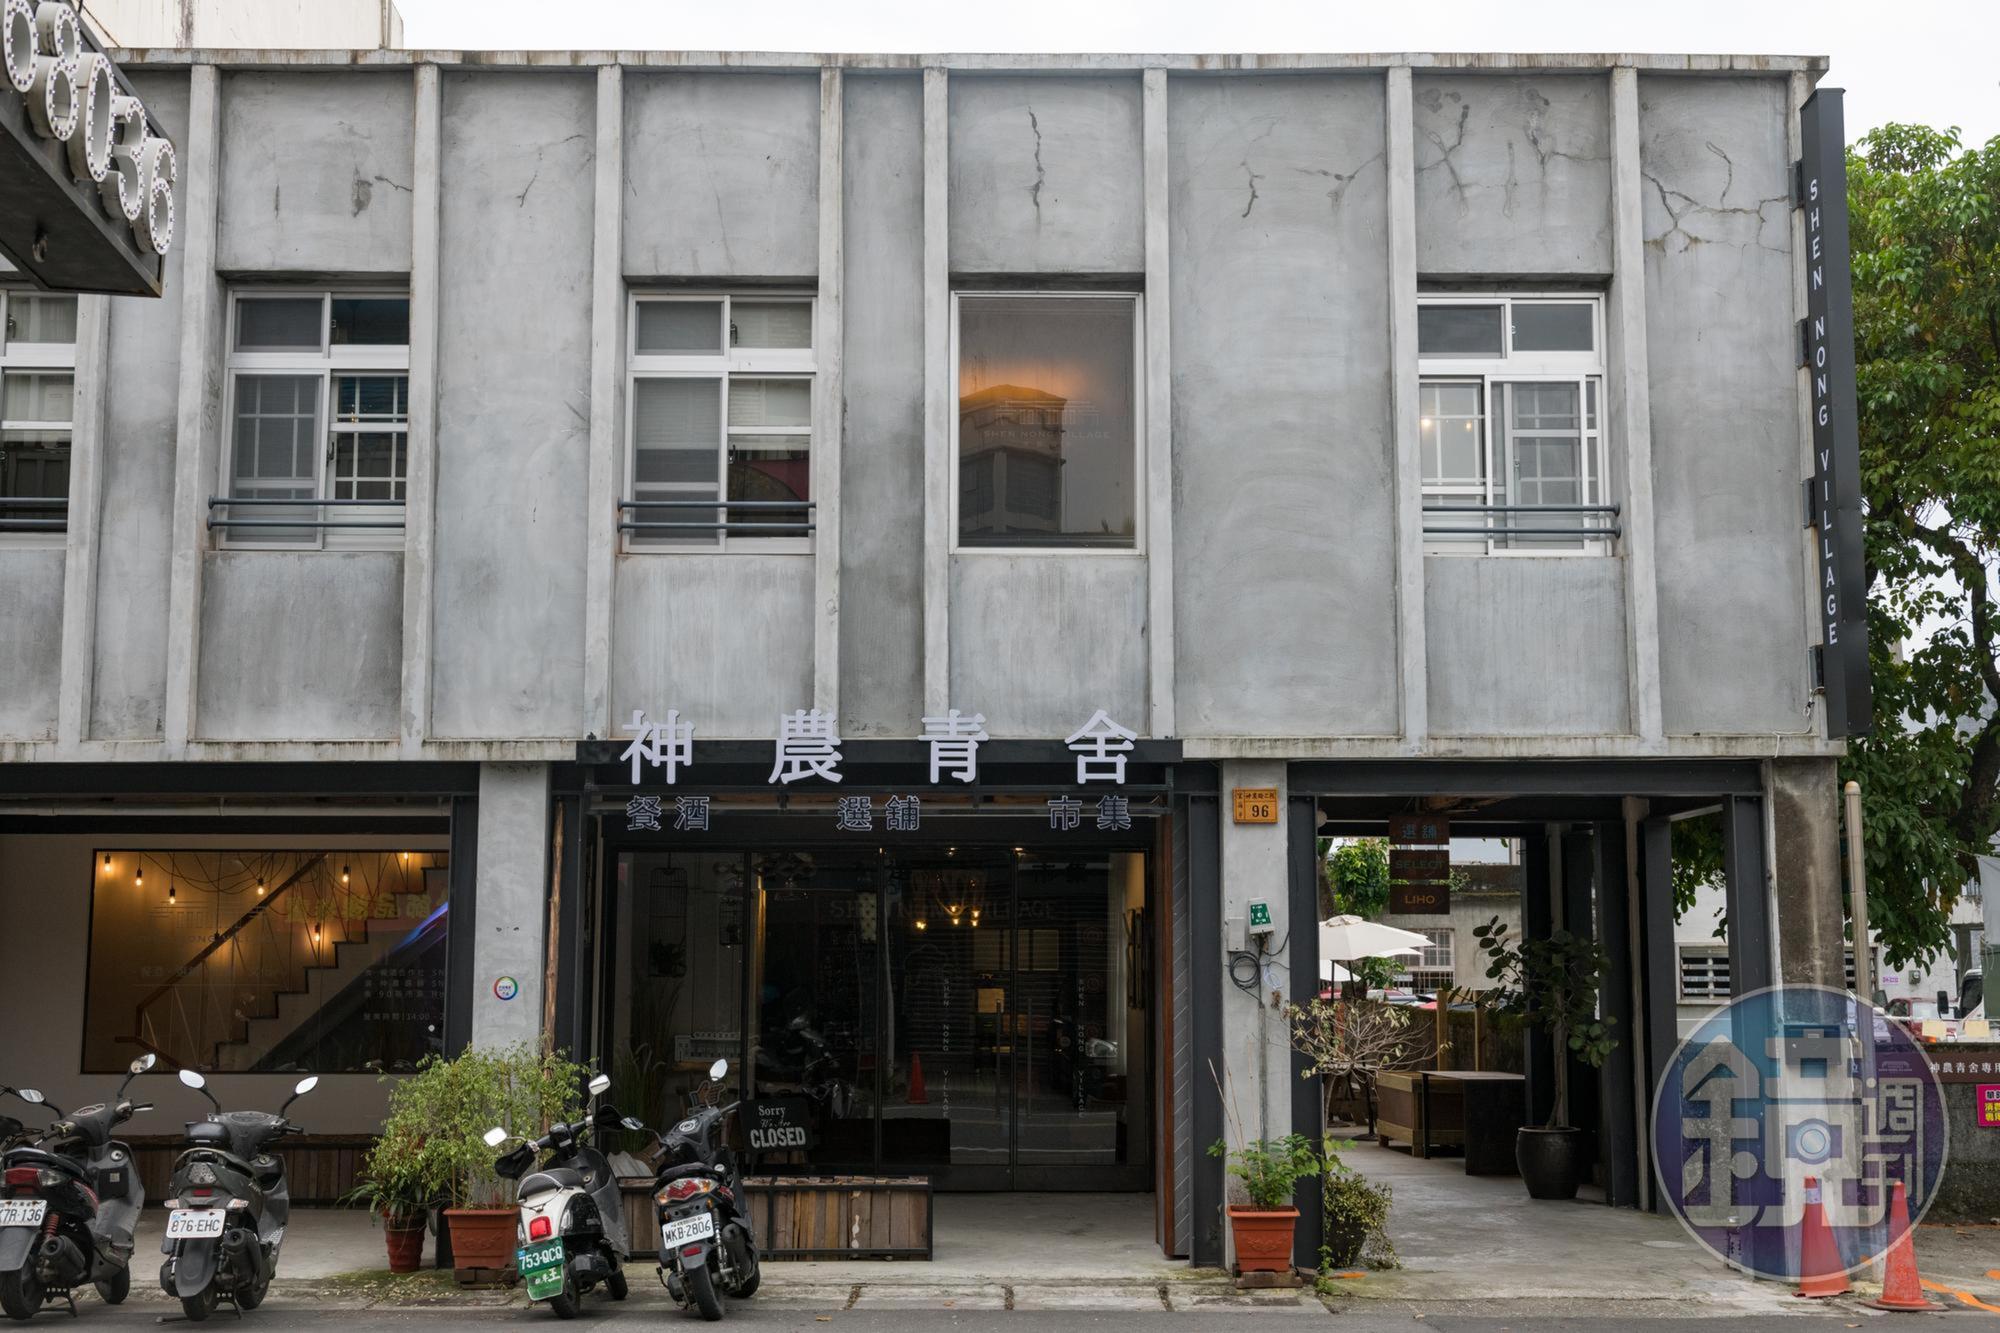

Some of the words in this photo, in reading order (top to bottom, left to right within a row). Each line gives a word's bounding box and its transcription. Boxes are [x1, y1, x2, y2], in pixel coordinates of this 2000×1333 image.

[1809, 178, 1823, 291] SHEN
[1815, 316, 1828, 426] NONG
[1820, 449, 1838, 646] VILLAGE
[620, 708, 1138, 785] 神農青舍
[626, 795, 710, 832] 餐酒
[836, 794, 920, 832] 選舖
[1047, 795, 1132, 831] 市集
[1251, 804, 1269, 818] 96
[1404, 894, 1436, 905] LIHO
[758, 1104, 786, 1119] Sorry
[750, 1126, 807, 1150] CLOSED
[0, 1208, 42, 1223] 7R-136
[664, 1219, 711, 1244] MKB-2806
